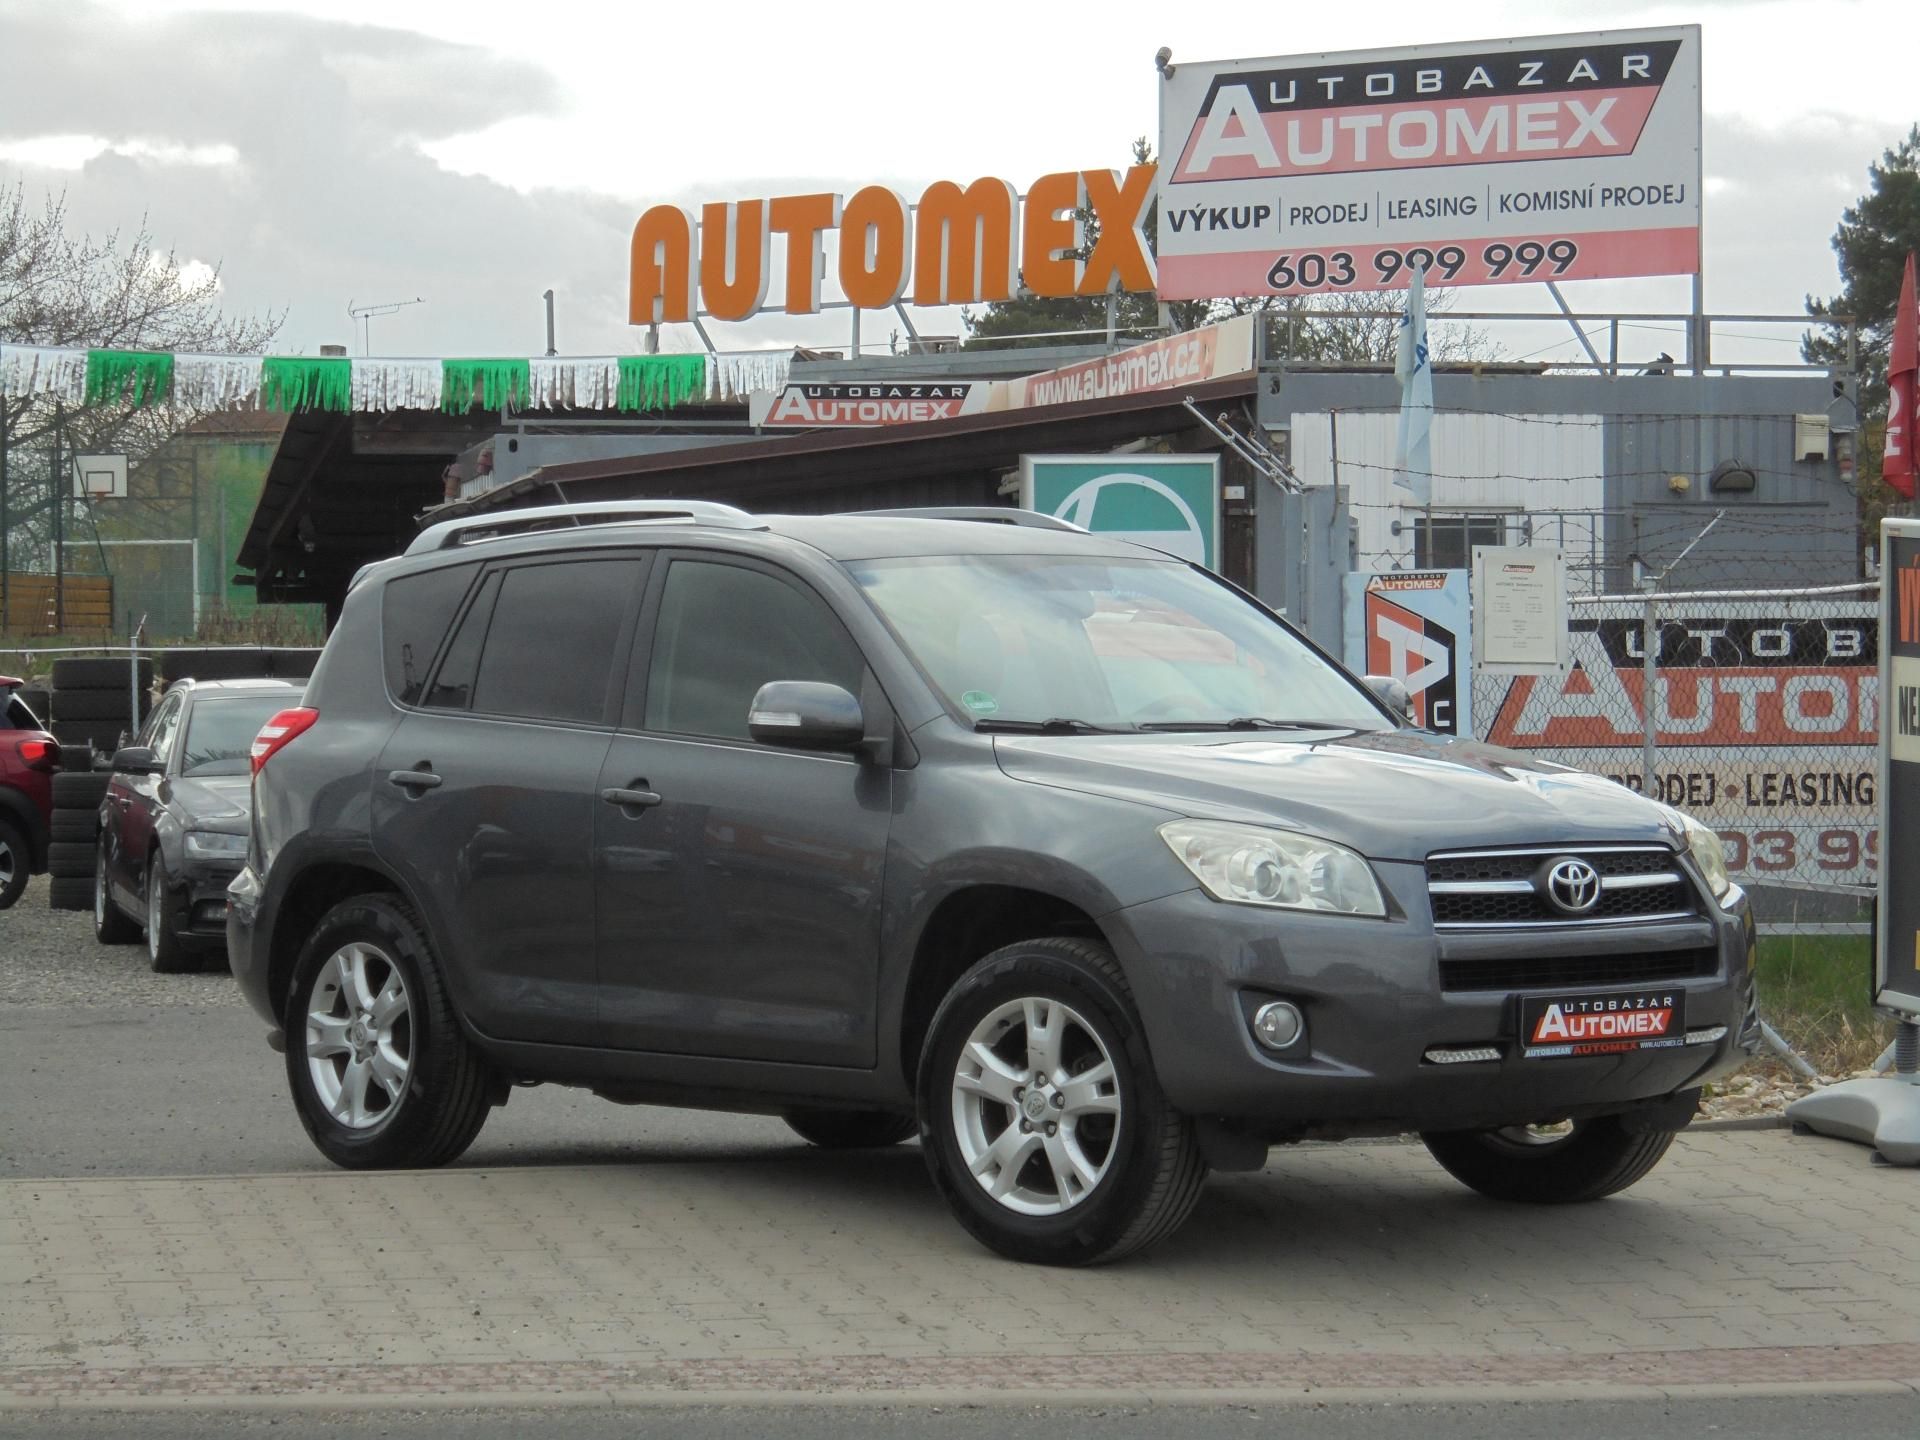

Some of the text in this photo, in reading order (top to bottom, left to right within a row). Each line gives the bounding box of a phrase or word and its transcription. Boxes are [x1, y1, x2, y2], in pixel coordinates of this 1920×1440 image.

[1185, 84, 1619, 175] AUTOMEX
[1167, 182, 1686, 233] VÝKUP PRODEJ LEASING KOMISNÍ PRODEJ
[628, 164, 1160, 326] AUTOMEX
[1267, 240, 1578, 289] 603 999 999
[1034, 339, 1201, 406] www.automex.cz
[773, 386, 952, 422] AUTOMEX
[1368, 575, 1442, 590] AUTOMEX
[1512, 630, 1879, 737] AUTO
[1745, 771, 1874, 807] LEASING
[1816, 829, 1879, 871] 9
[1538, 1004, 1664, 1039] AUTOMEX
[1523, 1046, 1572, 1058] AUTOBAZAR
[1573, 1041, 1638, 1055] AUTOMEX
